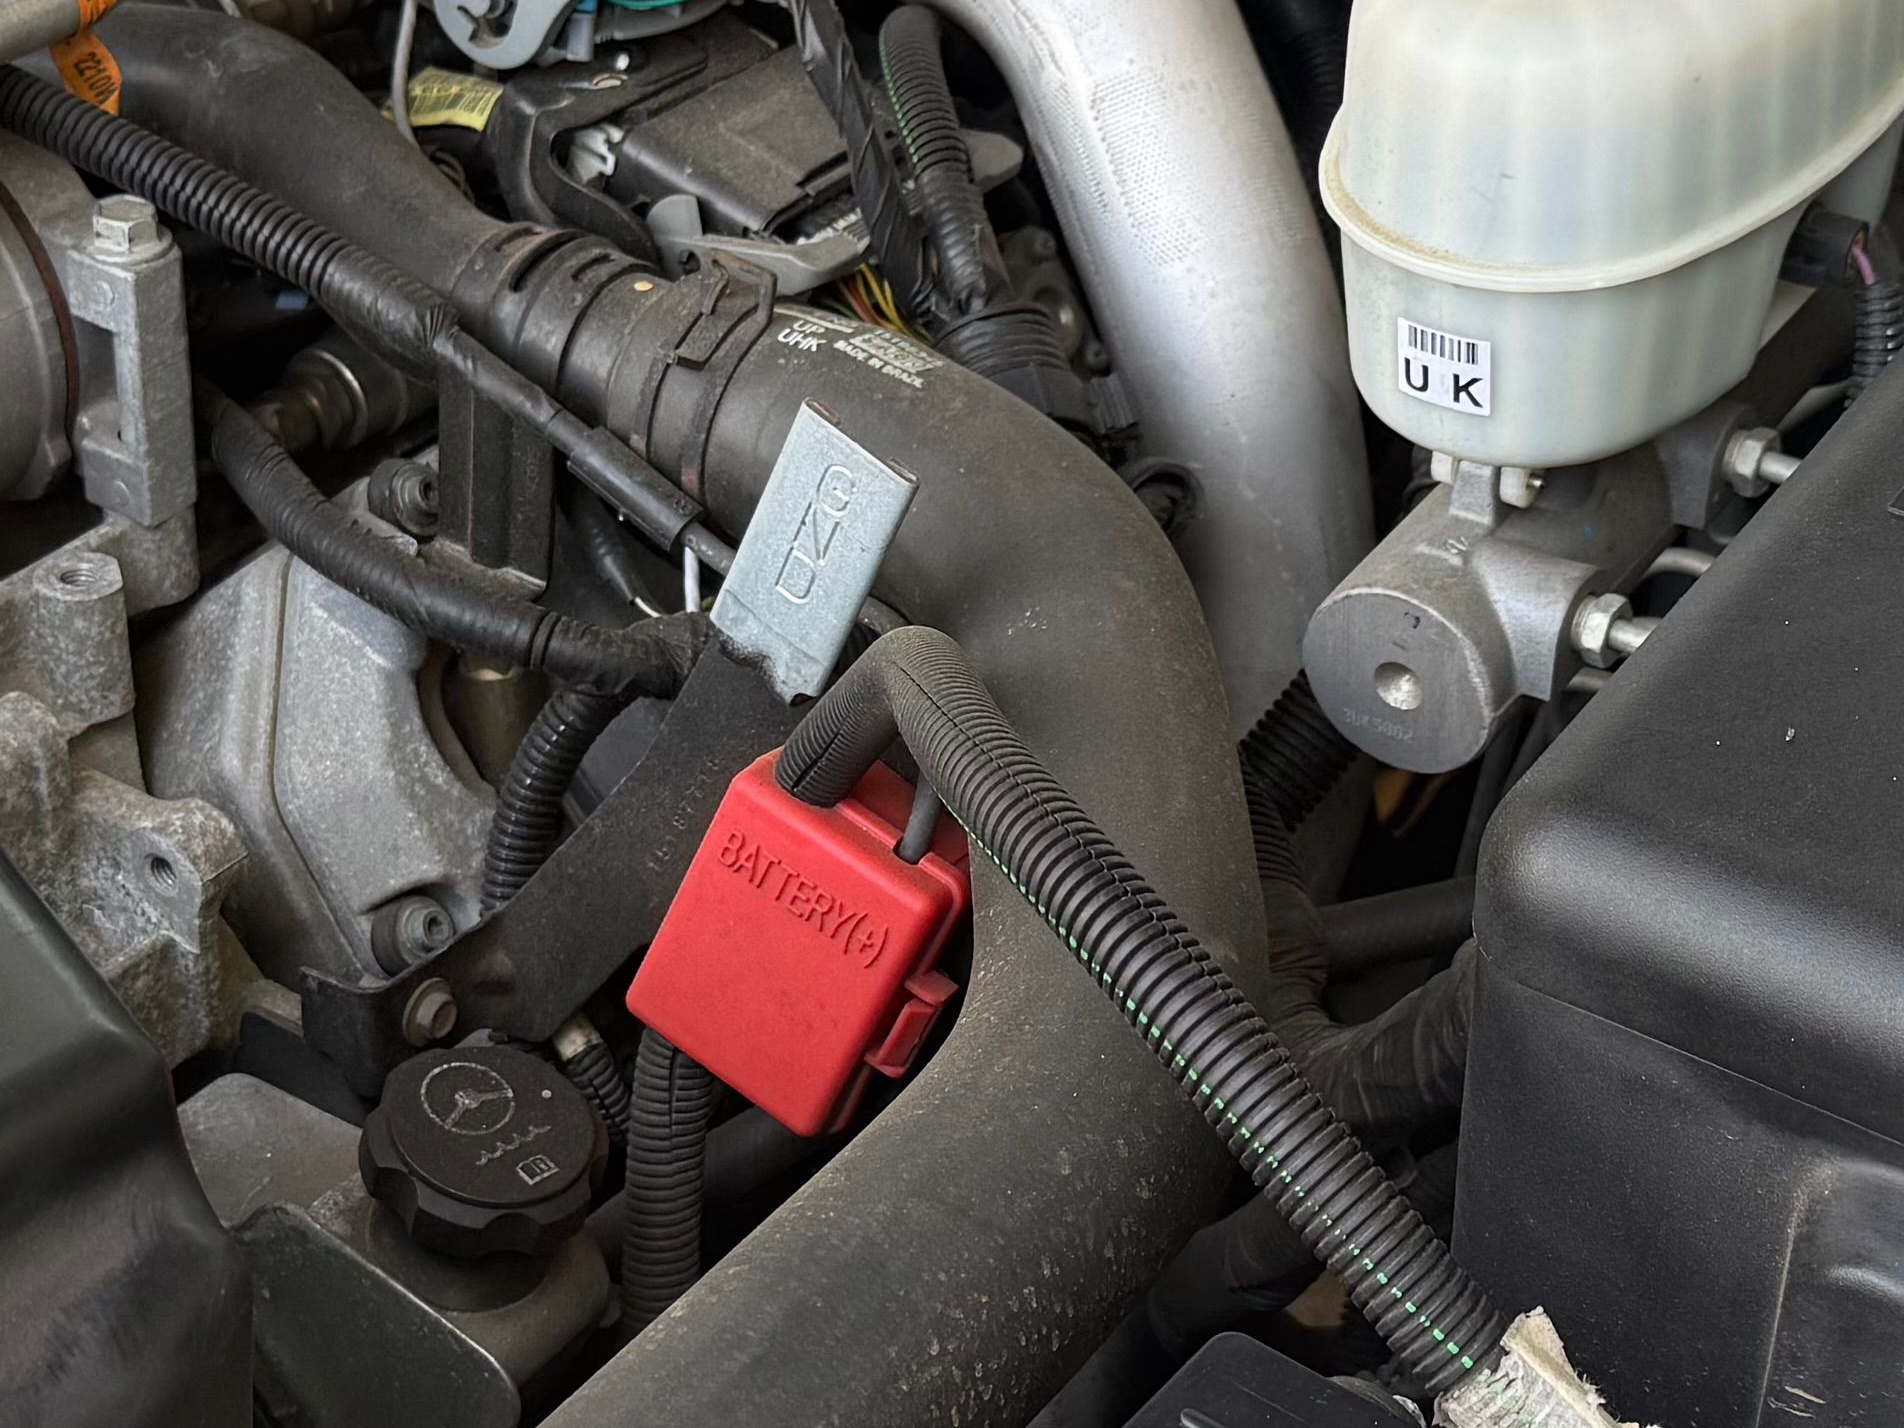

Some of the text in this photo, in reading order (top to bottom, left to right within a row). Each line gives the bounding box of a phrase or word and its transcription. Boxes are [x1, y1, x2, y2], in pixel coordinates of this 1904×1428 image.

[793, 320, 826, 335] UP
[833, 340, 870, 362] MADE
[882, 365, 925, 389] BRAZIL
[718, 831, 889, 969] BATTERY(+)
